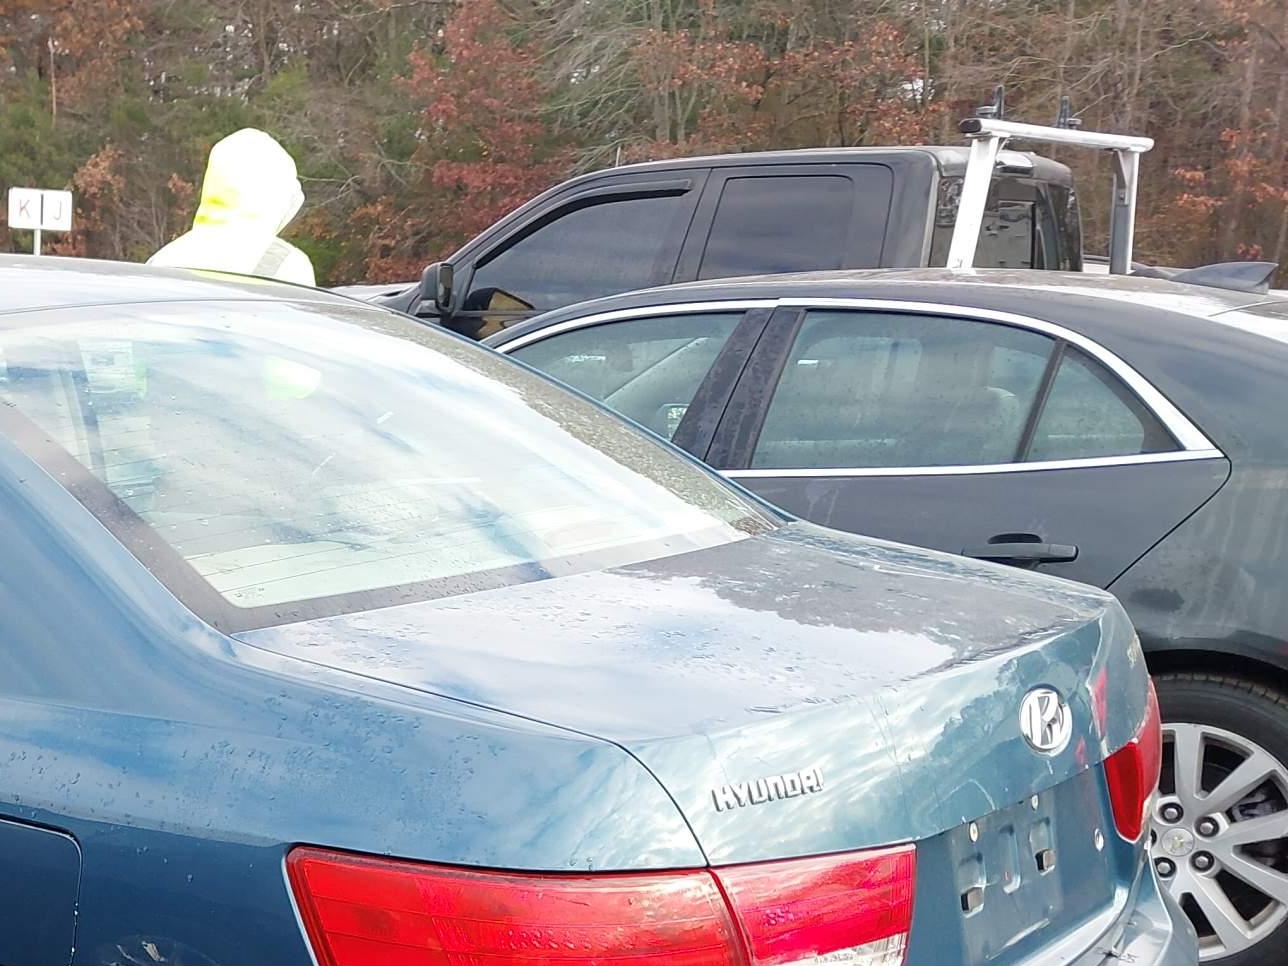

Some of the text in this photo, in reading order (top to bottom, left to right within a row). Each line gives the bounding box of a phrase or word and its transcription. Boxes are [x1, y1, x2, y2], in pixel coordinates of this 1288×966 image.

[18, 199, 63, 221] K J
[711, 766, 825, 813] HYUNDAI
